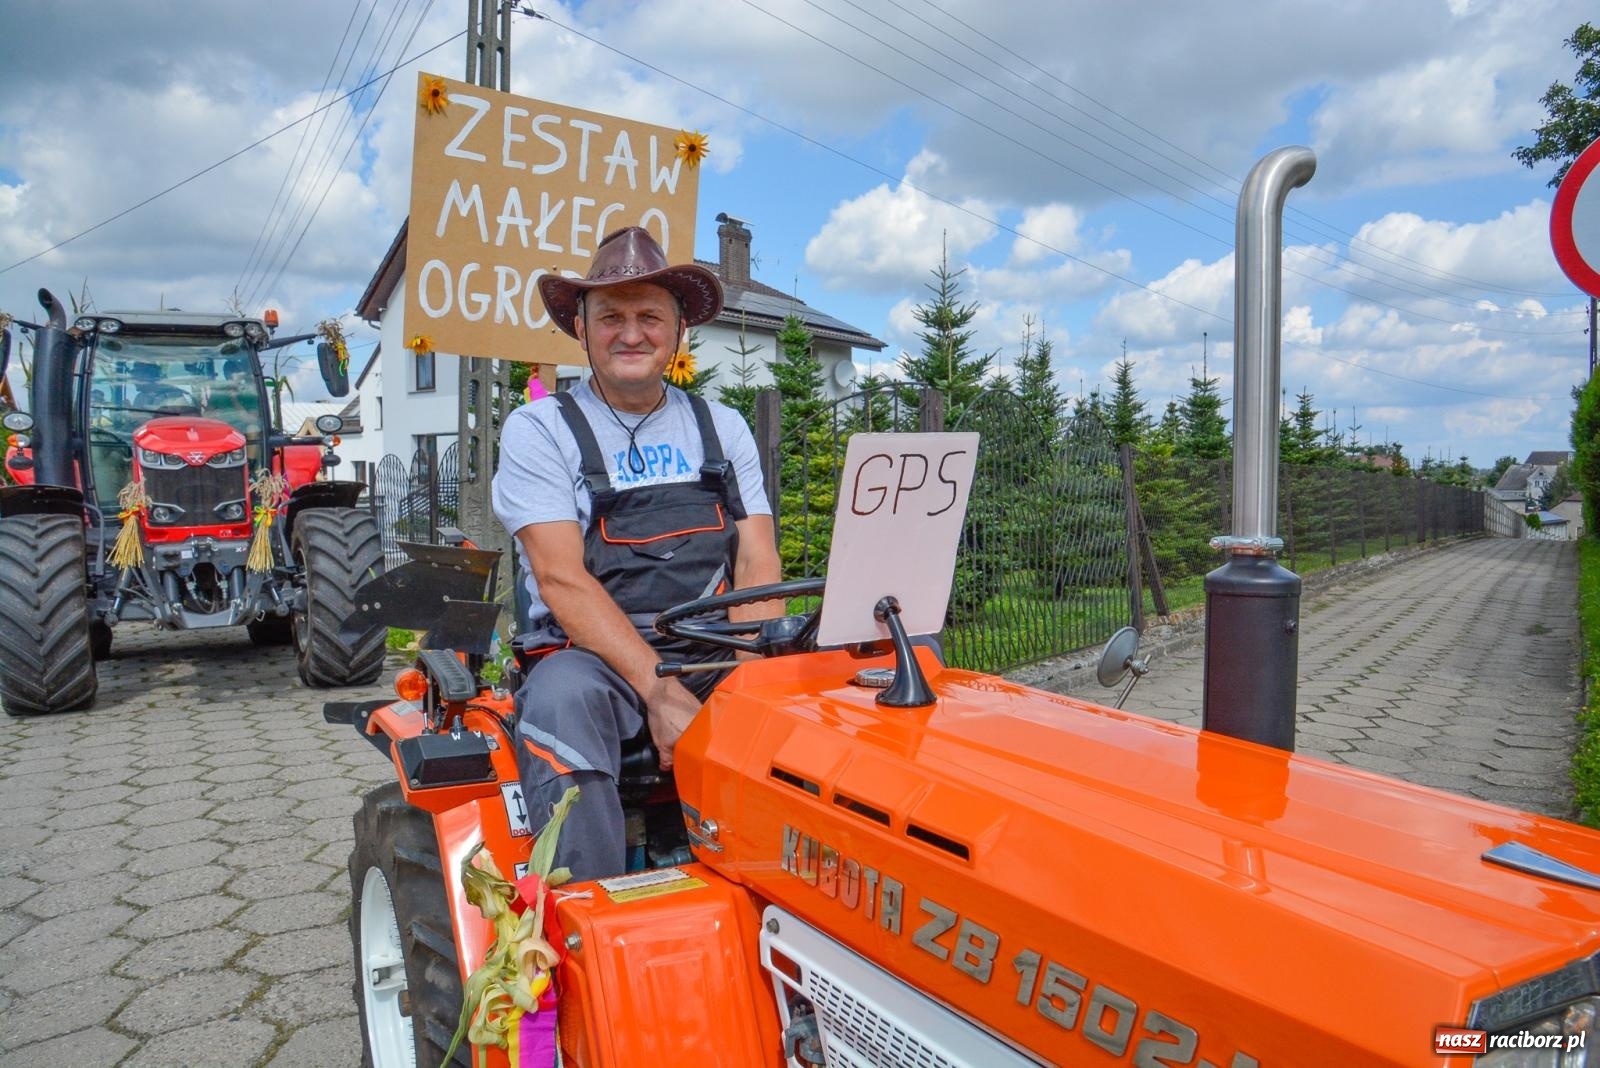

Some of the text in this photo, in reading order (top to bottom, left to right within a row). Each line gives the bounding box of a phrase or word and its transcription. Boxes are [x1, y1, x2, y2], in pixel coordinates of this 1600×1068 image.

[444, 93, 683, 195] ZESTAW
[418, 258, 584, 329] OGRO
[613, 443, 692, 482] KAPPA
[851, 450, 966, 516] GPS
[781, 823, 904, 936] KUBOTA
